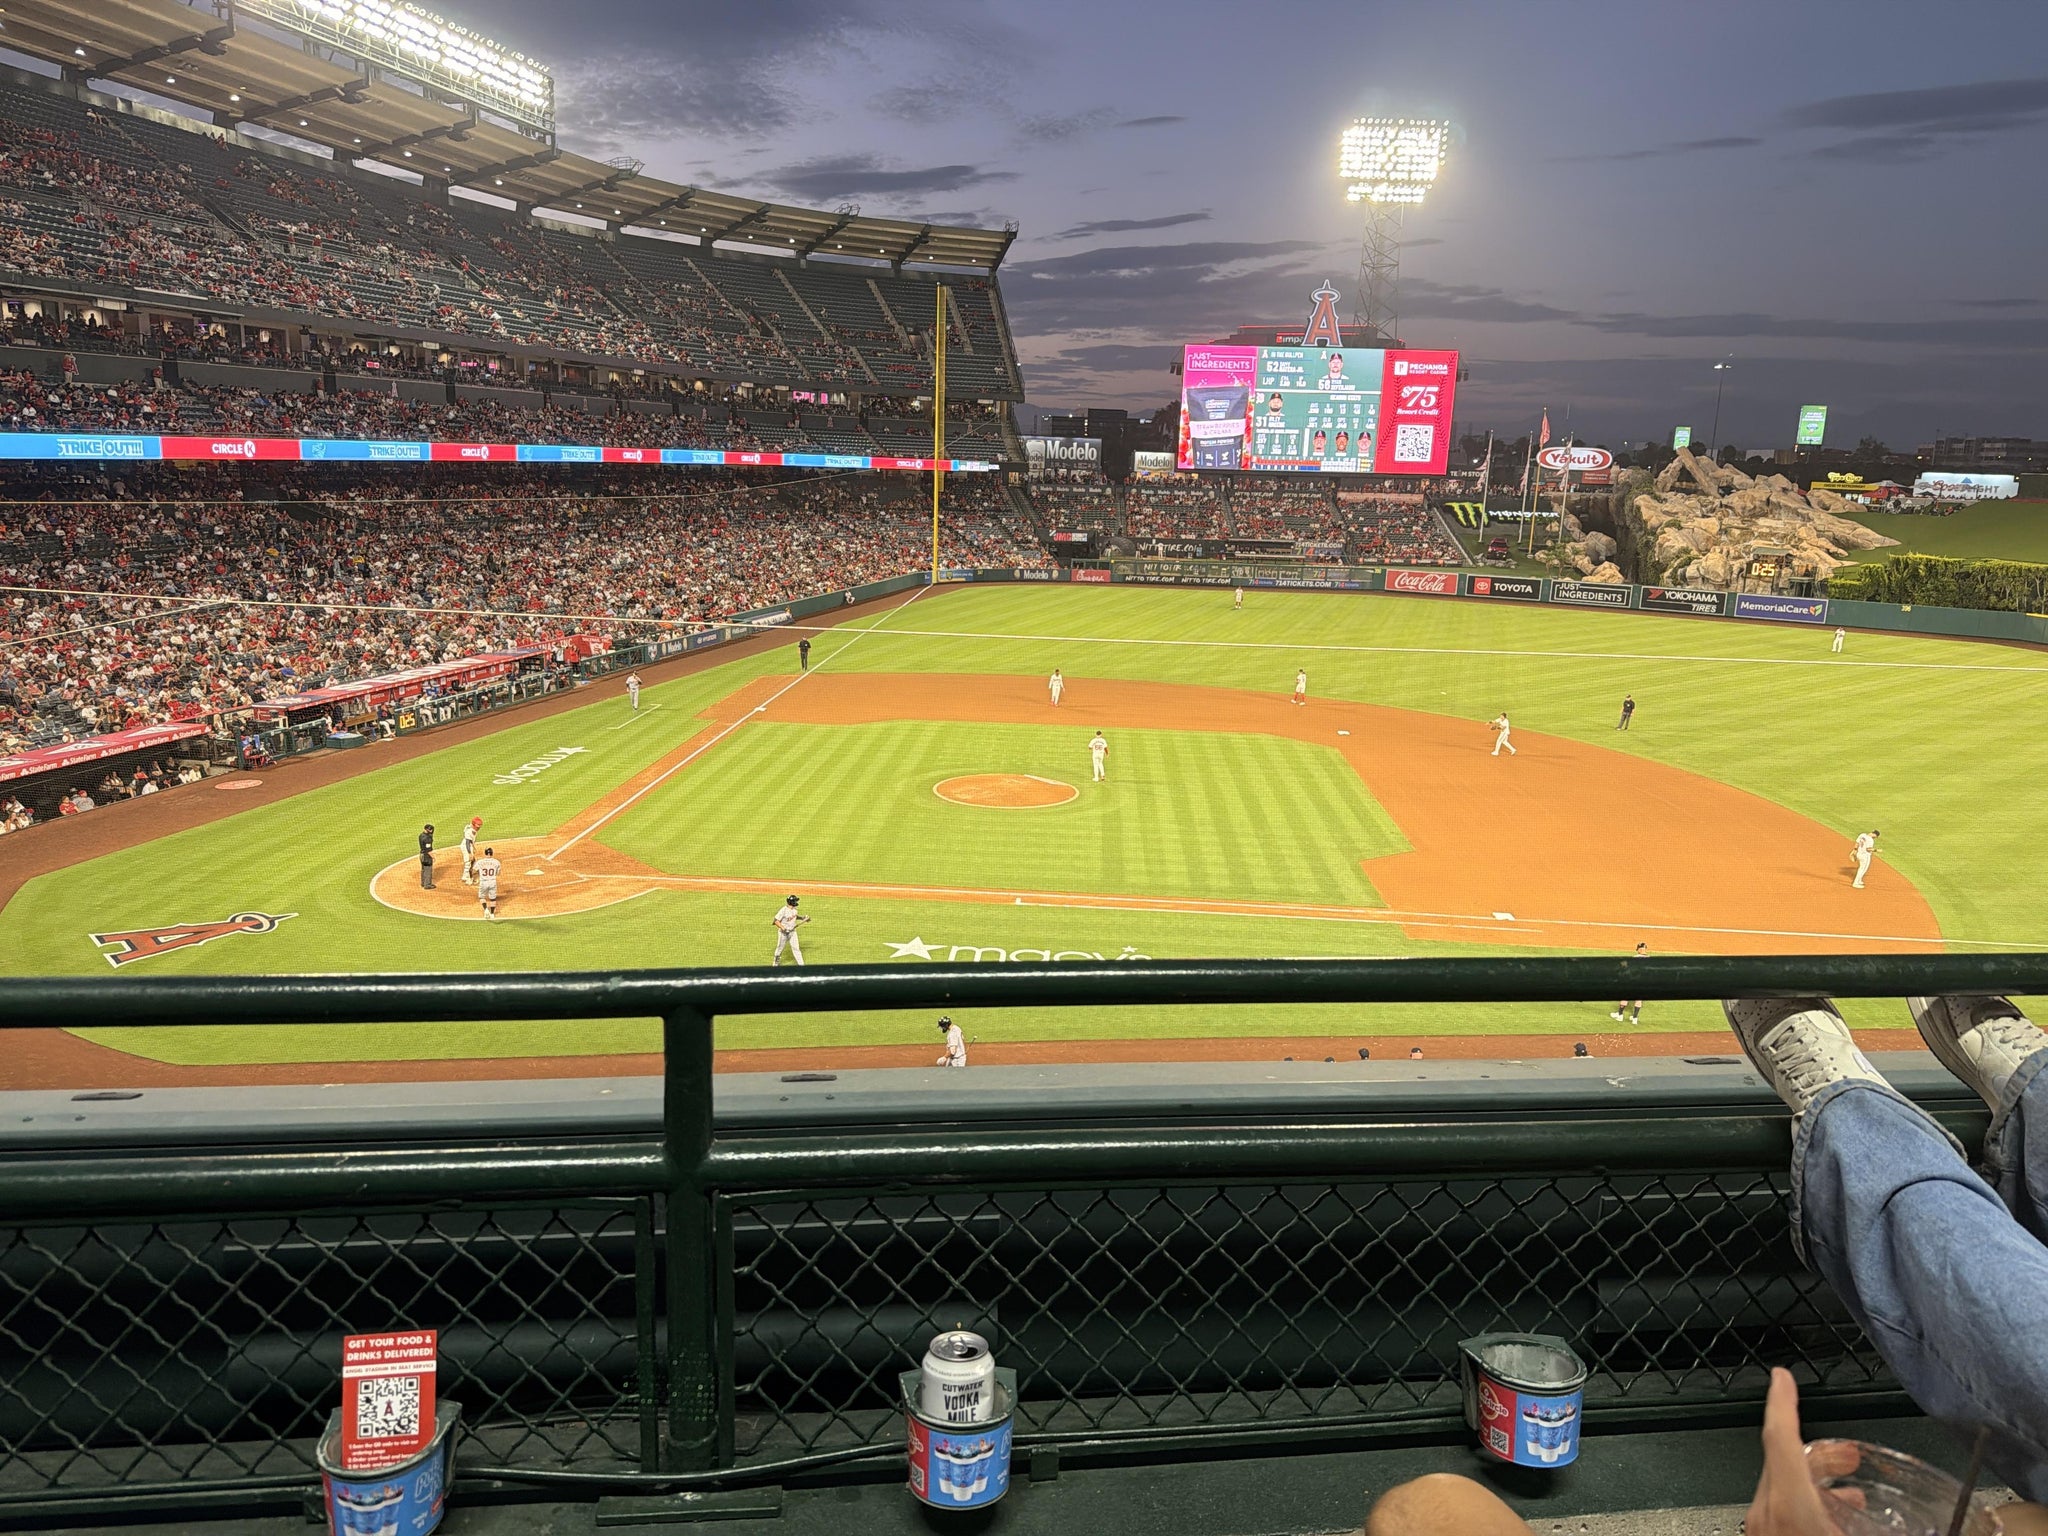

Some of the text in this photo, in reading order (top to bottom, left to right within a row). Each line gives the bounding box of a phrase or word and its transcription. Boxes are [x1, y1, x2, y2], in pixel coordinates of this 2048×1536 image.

[1301, 279, 1343, 347] A
[1191, 360, 1250, 370] INGREDIENTS
[1410, 363, 1449, 371] PECHANGA
[1401, 385, 1439, 408] $75
[1418, 408, 1440, 416] Credit
[57, 439, 101, 456] STRIKE
[212, 440, 256, 458] CIRCLE K
[369, 444, 396, 458] STRIKE
[461, 448, 481, 457] CIRCLE
[1046, 440, 1097, 461] Modelo
[1139, 454, 1170, 468] Modelo
[1551, 452, 1601, 465] Yakult
[1488, 510, 1560, 518] MONSTER
[1164, 543, 1197, 553] TIRE.CO
[1023, 570, 1049, 580] Modelo
[1751, 562, 1776, 577] 0:25
[1275, 580, 1332, 588] 714TICKETS.COM
[1395, 572, 1447, 592] Coca-Cola
[1493, 582, 1533, 594] TOYOTA
[1558, 589, 1623, 602] INGREDIENTS
[1665, 590, 1720, 603] YOKOHAMA
[1691, 603, 1717, 613] TIRES
[1740, 601, 1809, 615] MemorialCare
[482, 868, 495, 877] 30
[348, 1335, 432, 1349] GET YOUR FOOD &
[346, 1347, 433, 1362] DRINKS DELIVERED!
[942, 1380, 984, 1393] CUTWATER
[944, 1391, 980, 1411] VODKA
